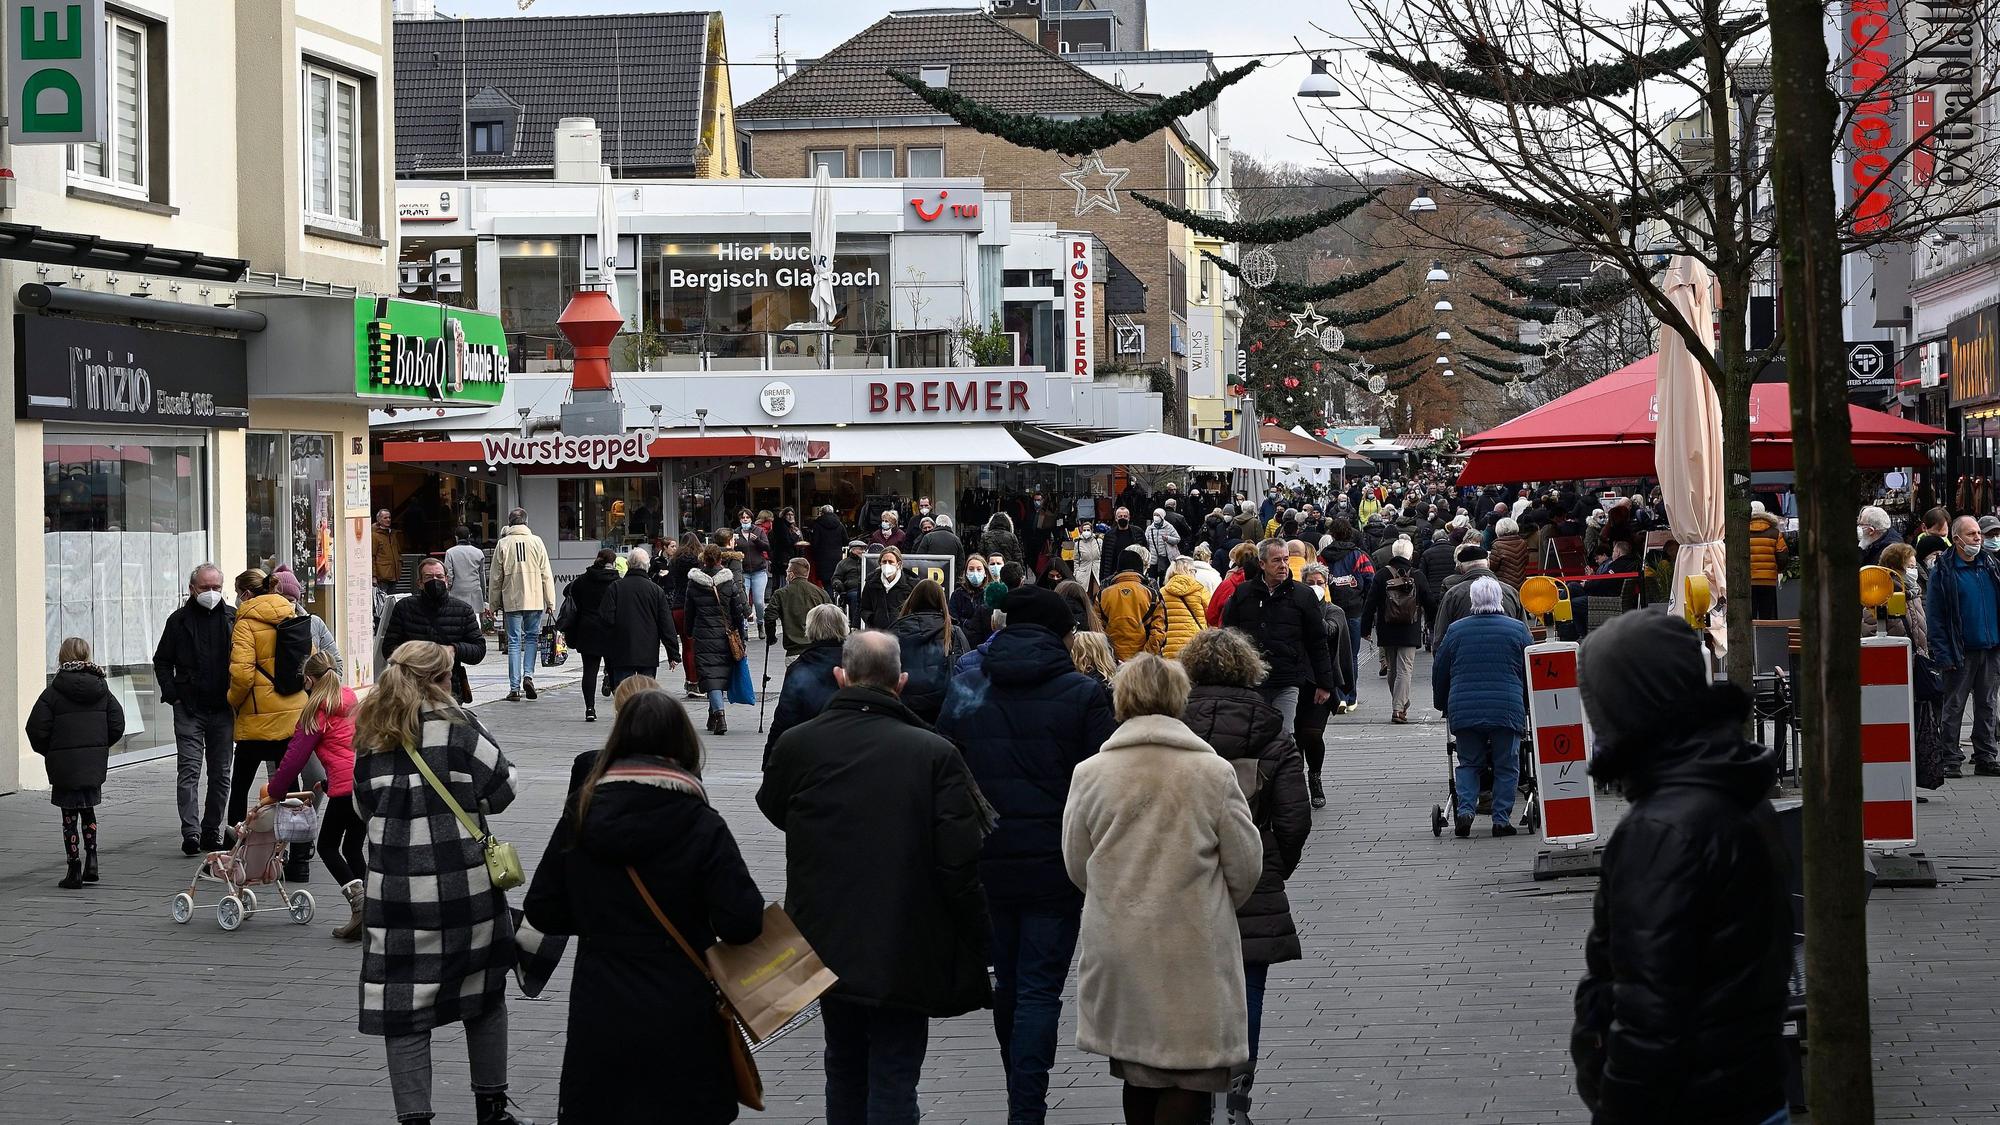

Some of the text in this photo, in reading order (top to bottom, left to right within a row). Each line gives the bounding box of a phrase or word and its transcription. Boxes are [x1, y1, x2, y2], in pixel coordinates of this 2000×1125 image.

[951, 204, 978, 219] TUI
[718, 242, 763, 261] Hier
[669, 269, 769, 293] Bergisch
[1070, 241, 1089, 376] RÖSELER
[1191, 330, 1203, 372] WILMS
[394, 334, 510, 401] BoBoQ Bubble Tea
[763, 388, 791, 397] BREMER
[868, 380, 1031, 413] BREMER
[486, 433, 645, 465] Wurstseppel
